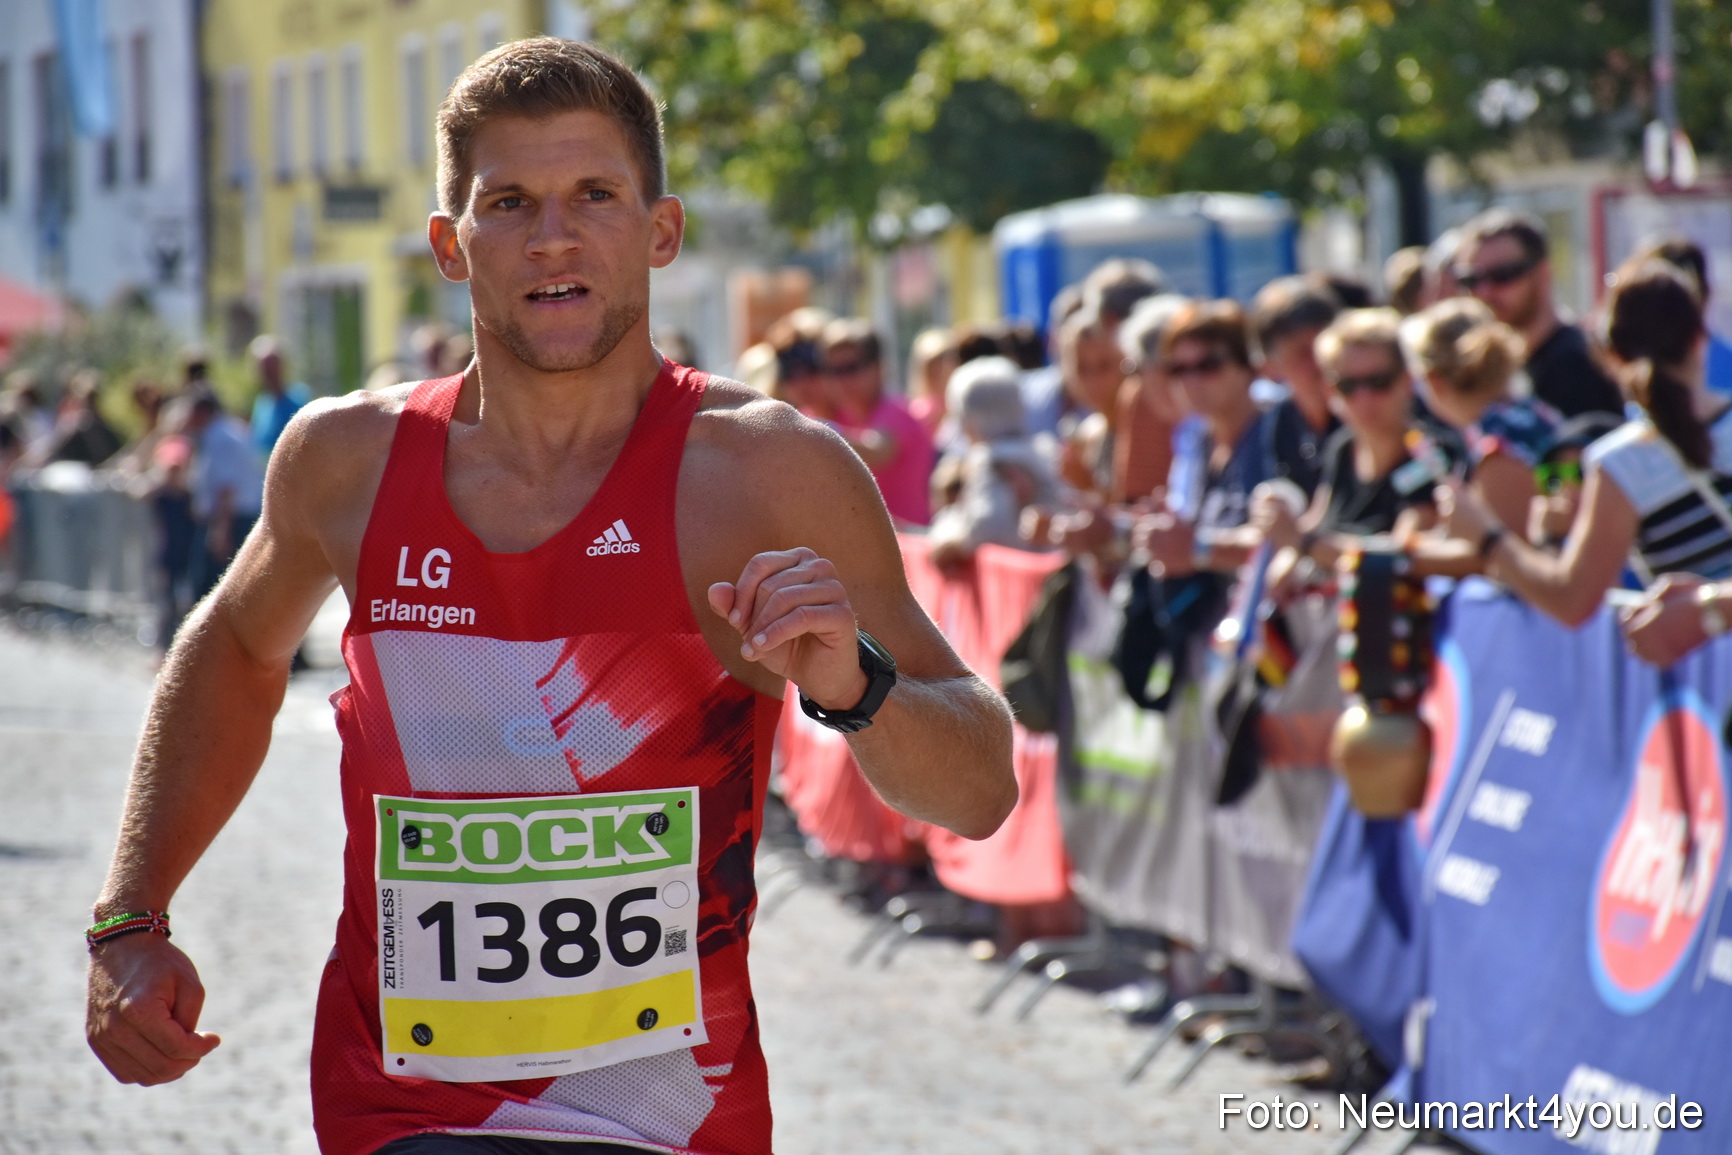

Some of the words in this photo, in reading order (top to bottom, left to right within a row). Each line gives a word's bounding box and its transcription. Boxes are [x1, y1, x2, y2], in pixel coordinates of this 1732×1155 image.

[396, 546, 452, 589] LG
[586, 540, 641, 557] adidas
[370, 598, 476, 629] Erlangen
[400, 805, 670, 872] BOCK
[416, 886, 662, 984] 1386
